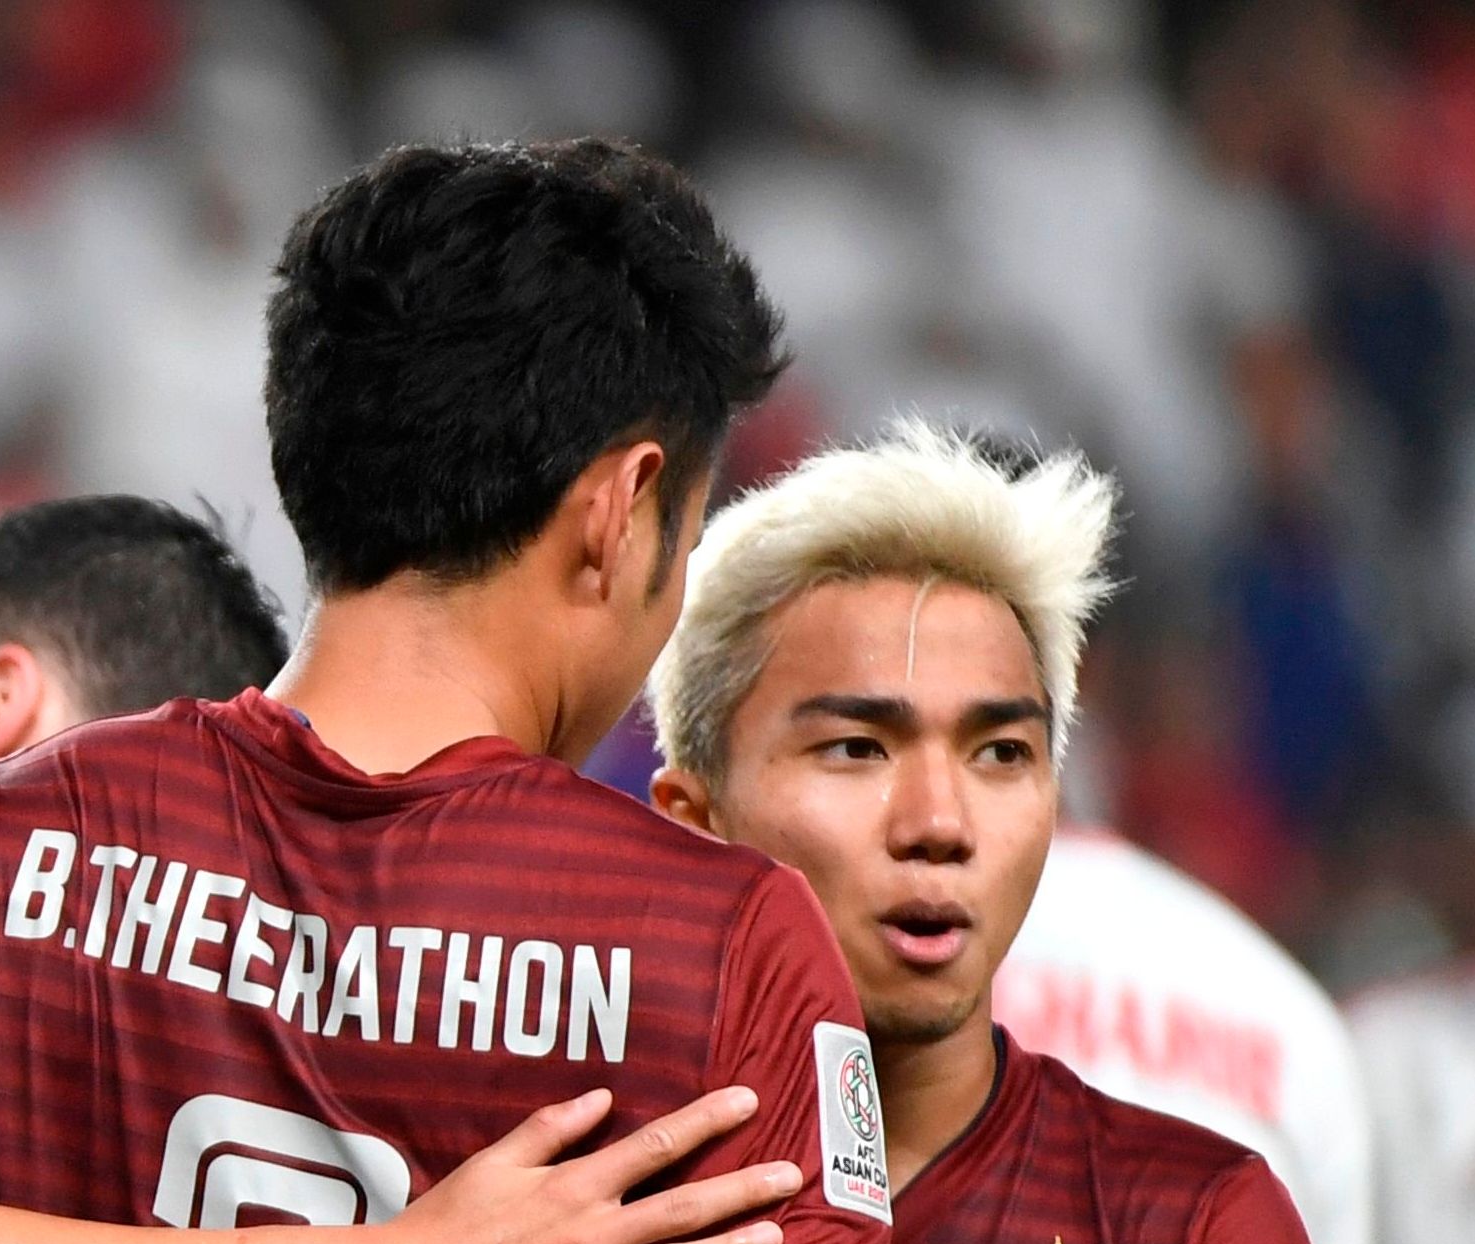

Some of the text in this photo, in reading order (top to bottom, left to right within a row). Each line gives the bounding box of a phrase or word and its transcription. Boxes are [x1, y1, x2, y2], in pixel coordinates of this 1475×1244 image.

[4, 829, 631, 1063] B.THEERATHON
[857, 1144, 874, 1163] AFC
[832, 1154, 887, 1189] ASIAN CU
